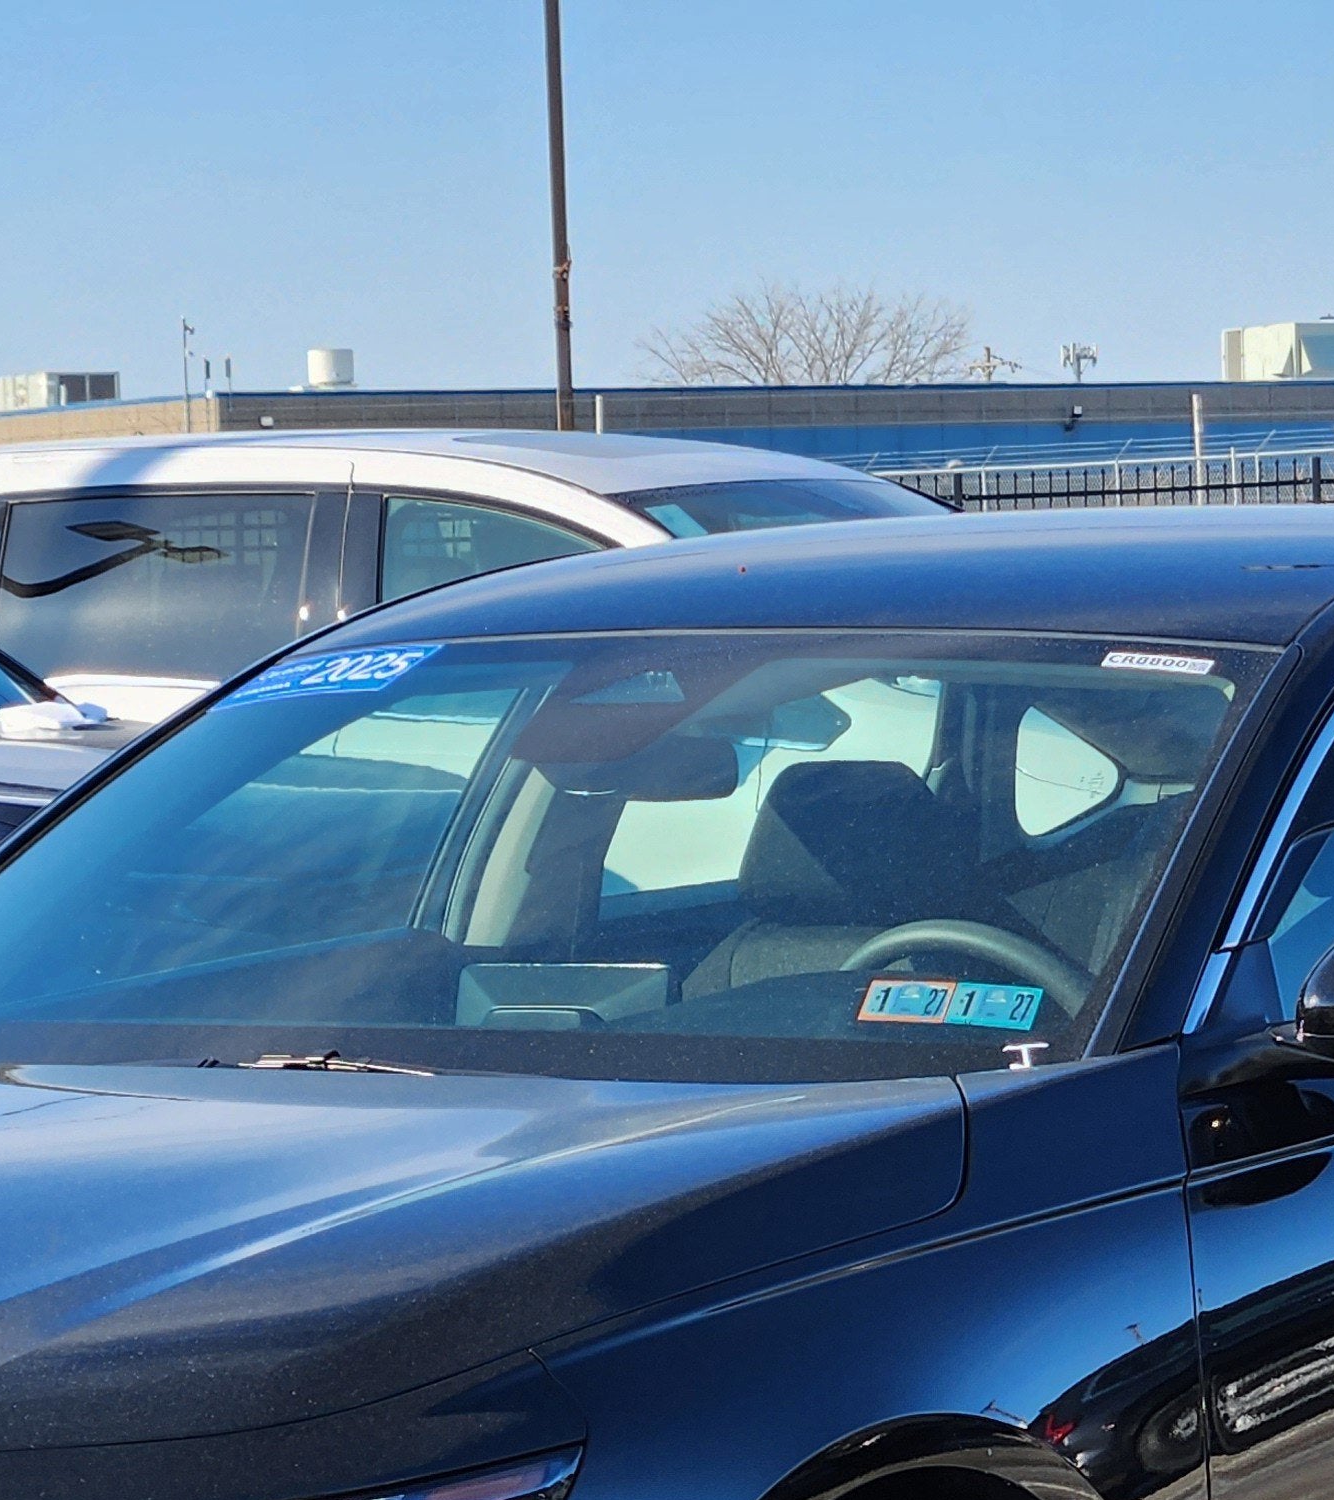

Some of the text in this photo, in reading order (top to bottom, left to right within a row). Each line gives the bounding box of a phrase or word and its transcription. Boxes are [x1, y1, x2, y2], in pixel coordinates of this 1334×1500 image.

[300, 652, 424, 685] 2025
[924, 988, 948, 1016] 27
[1009, 993, 1034, 1022] 27
